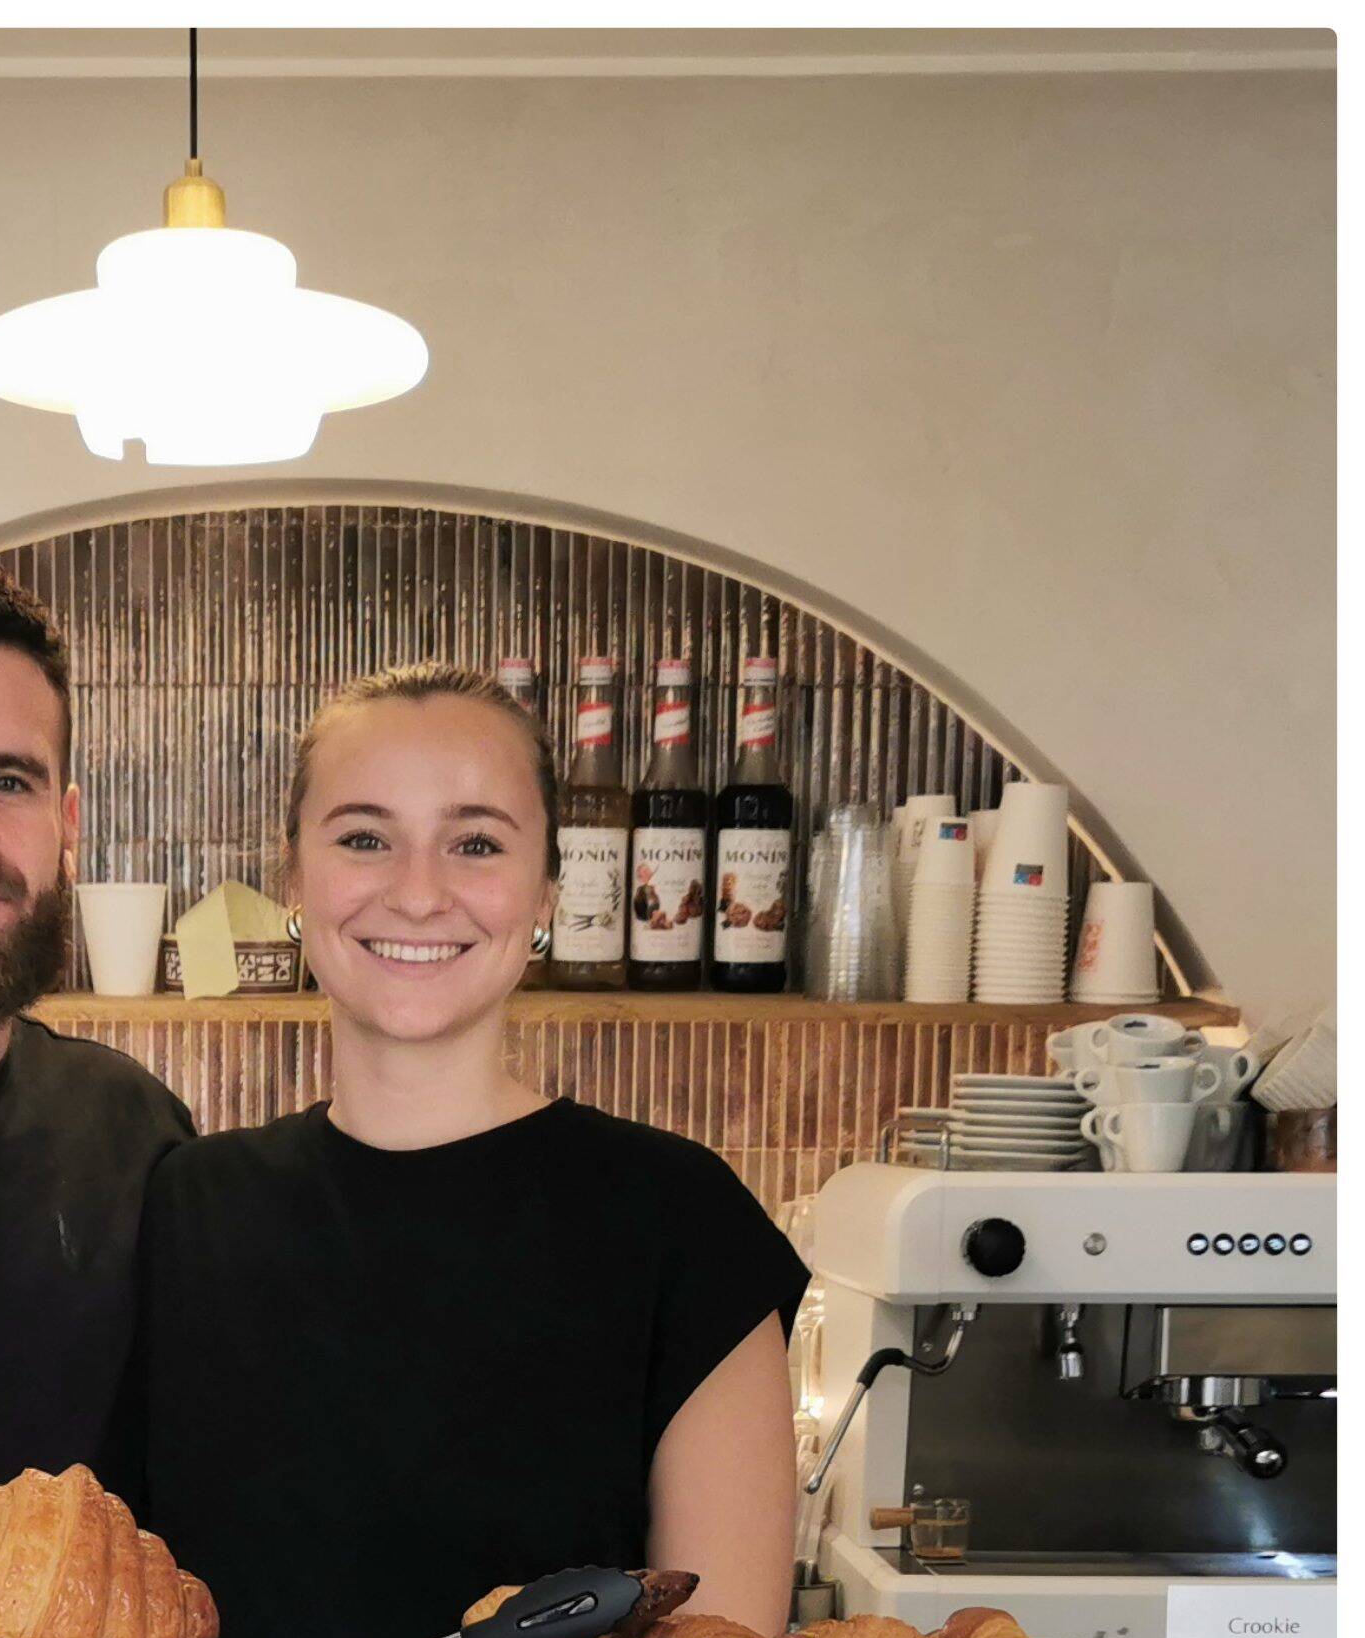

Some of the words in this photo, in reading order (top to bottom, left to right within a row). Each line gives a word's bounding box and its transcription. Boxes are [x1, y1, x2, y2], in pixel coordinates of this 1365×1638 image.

[640, 849, 703, 862] MONIN
[724, 850, 789, 864] MONIN
[1228, 1616, 1301, 1635] Crookie
